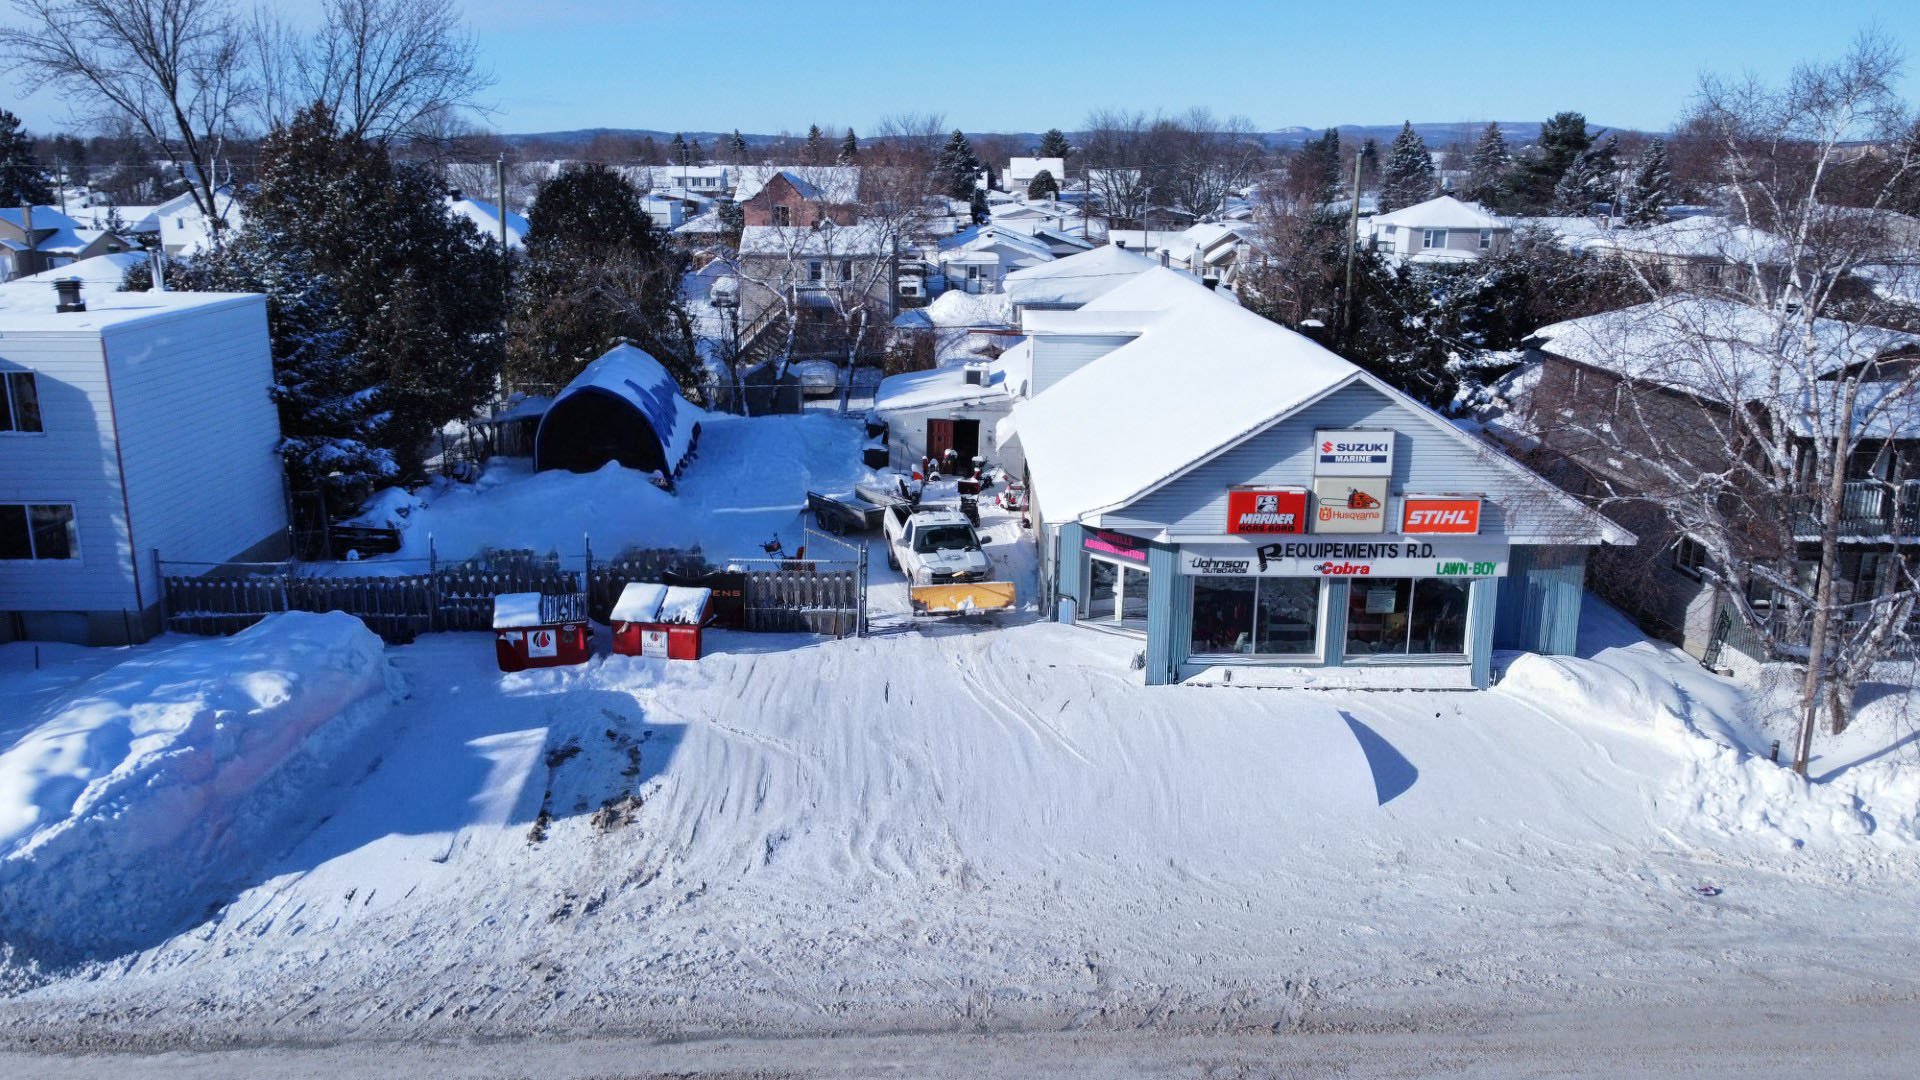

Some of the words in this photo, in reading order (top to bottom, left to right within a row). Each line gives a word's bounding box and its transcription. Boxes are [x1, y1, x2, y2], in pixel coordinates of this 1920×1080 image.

[1336, 443, 1388, 452] SUZUKI
[1335, 455, 1371, 463] MARINE
[1239, 513, 1294, 525] MARINER
[1332, 510, 1379, 521] Husqvarna
[1407, 510, 1470, 525] STIHL
[1285, 543, 1398, 558] EQUIPEMENTS
[1406, 543, 1436, 558] R.D.
[1192, 558, 1249, 568] Johnson
[1322, 562, 1370, 575] Cobra
[1436, 562, 1496, 575] LAWN-BOY
[712, 589, 741, 597] ENS
